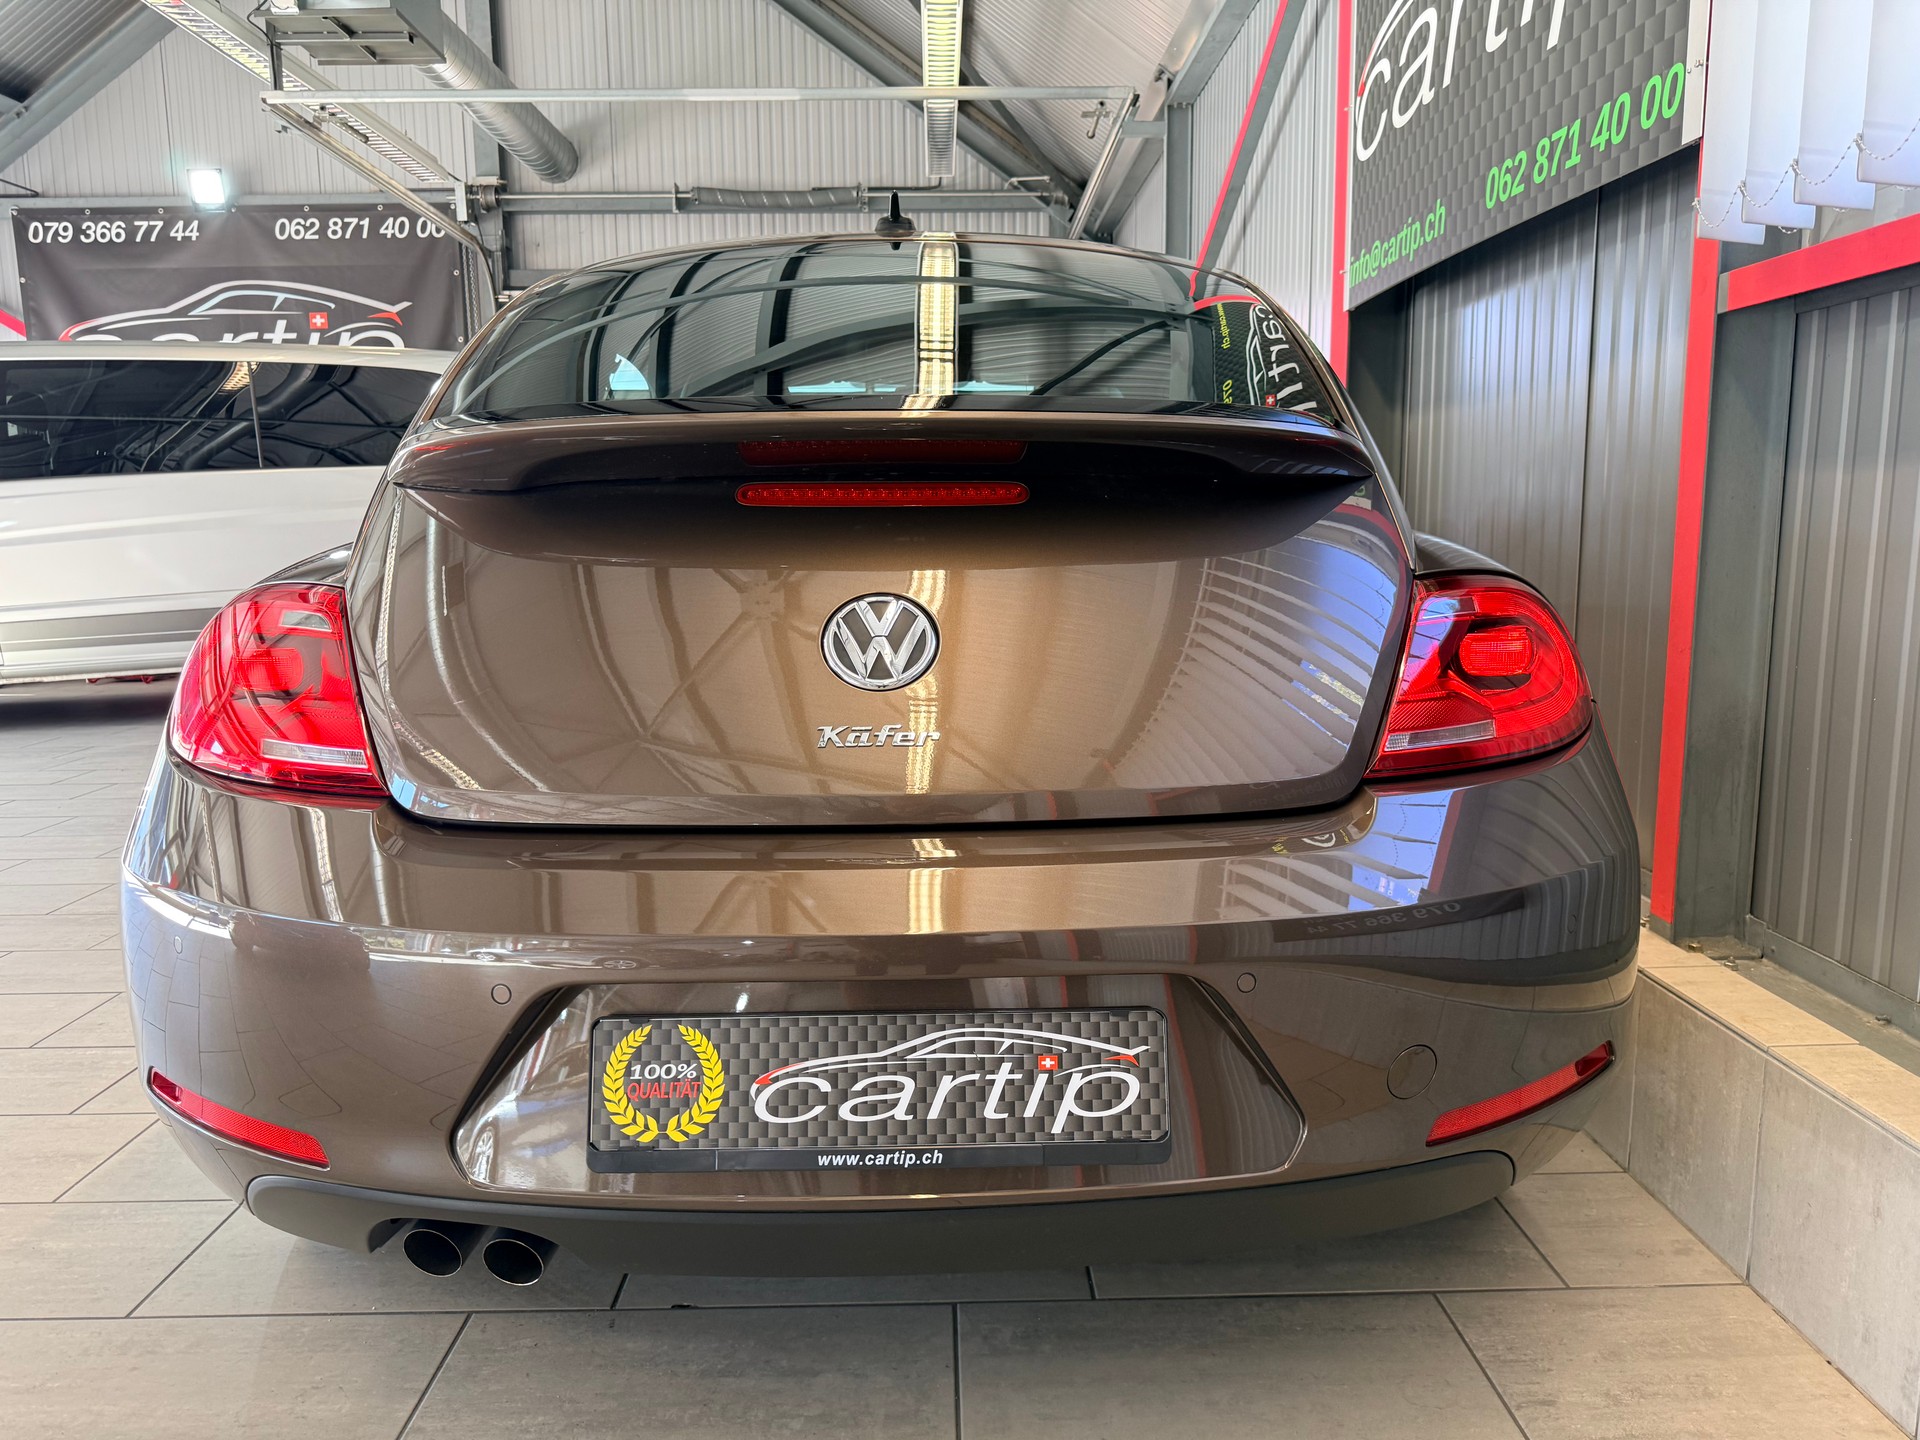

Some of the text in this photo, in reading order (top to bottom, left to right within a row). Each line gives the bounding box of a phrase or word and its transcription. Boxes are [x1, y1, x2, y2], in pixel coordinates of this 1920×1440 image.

[1485, 62, 1685, 209] 062 871 40 00
[28, 220, 199, 243] 079 366 77 44
[275, 217, 319, 240] 062
[327, 217, 370, 239] 871
[379, 216, 409, 239] 40
[1350, 198, 1446, 288] info@cartip.ch
[629, 1062, 697, 1080] 100%
[626, 1079, 701, 1101] QUALITÄT
[752, 1061, 1142, 1134] cartip
[817, 1149, 944, 1168] www.cartip.ch
